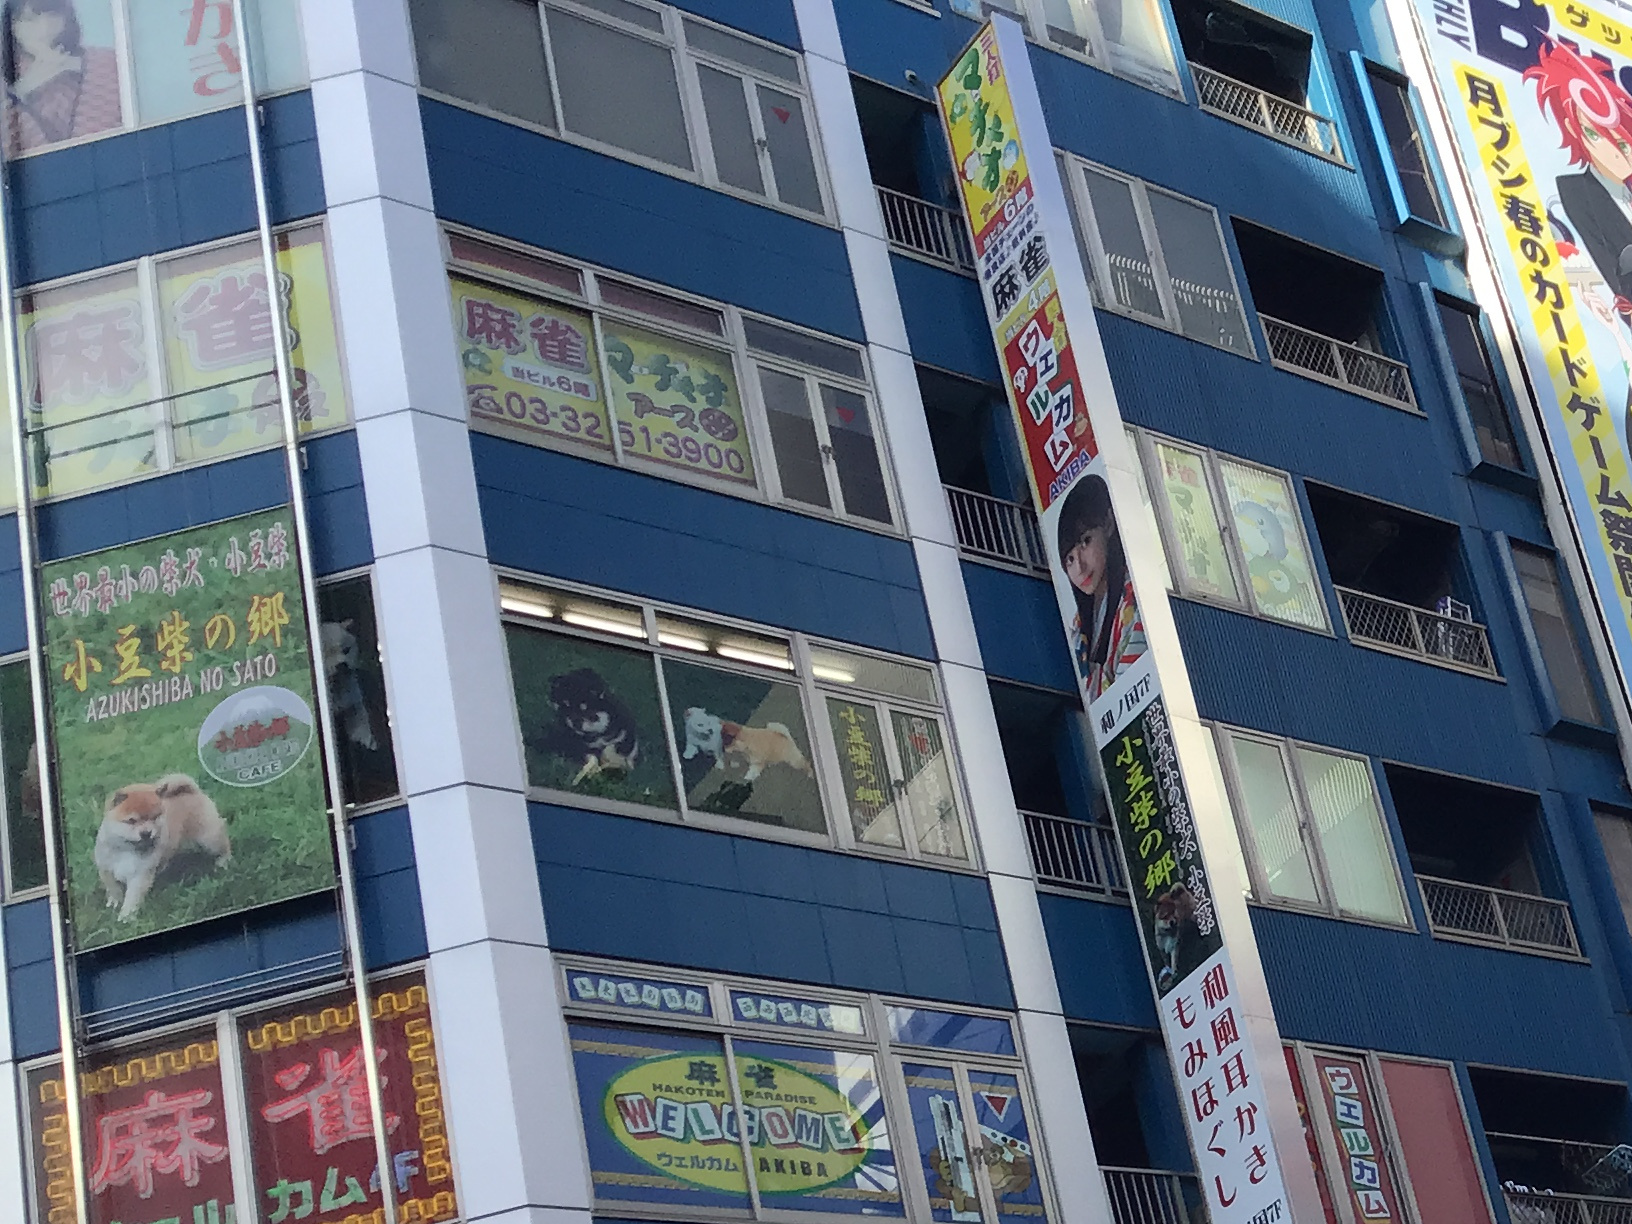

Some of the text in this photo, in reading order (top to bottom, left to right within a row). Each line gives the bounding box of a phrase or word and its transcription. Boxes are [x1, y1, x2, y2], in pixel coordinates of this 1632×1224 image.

[991, 233, 1049, 320] 麻雀
[465, 299, 588, 371] 麻雀
[1048, 448, 1091, 501] AKIBA
[63, 592, 290, 692] 小豆柴の郷
[86, 652, 277, 723] AZUKISHIBA NO SATO
[237, 761, 281, 781] CAFE
[1113, 734, 1176, 900] 小豆柴の郷
[652, 1082, 725, 1099] HAKOTEN
[684, 1060, 777, 1090] 麻雀
[1171, 994, 1237, 1209] もみほぐし
[1200, 962, 1267, 1185] 和風耳かき
[88, 1046, 402, 1198] 麻雀
[617, 1093, 853, 1151] WELCOME
[758, 1156, 829, 1178] AKIBA
